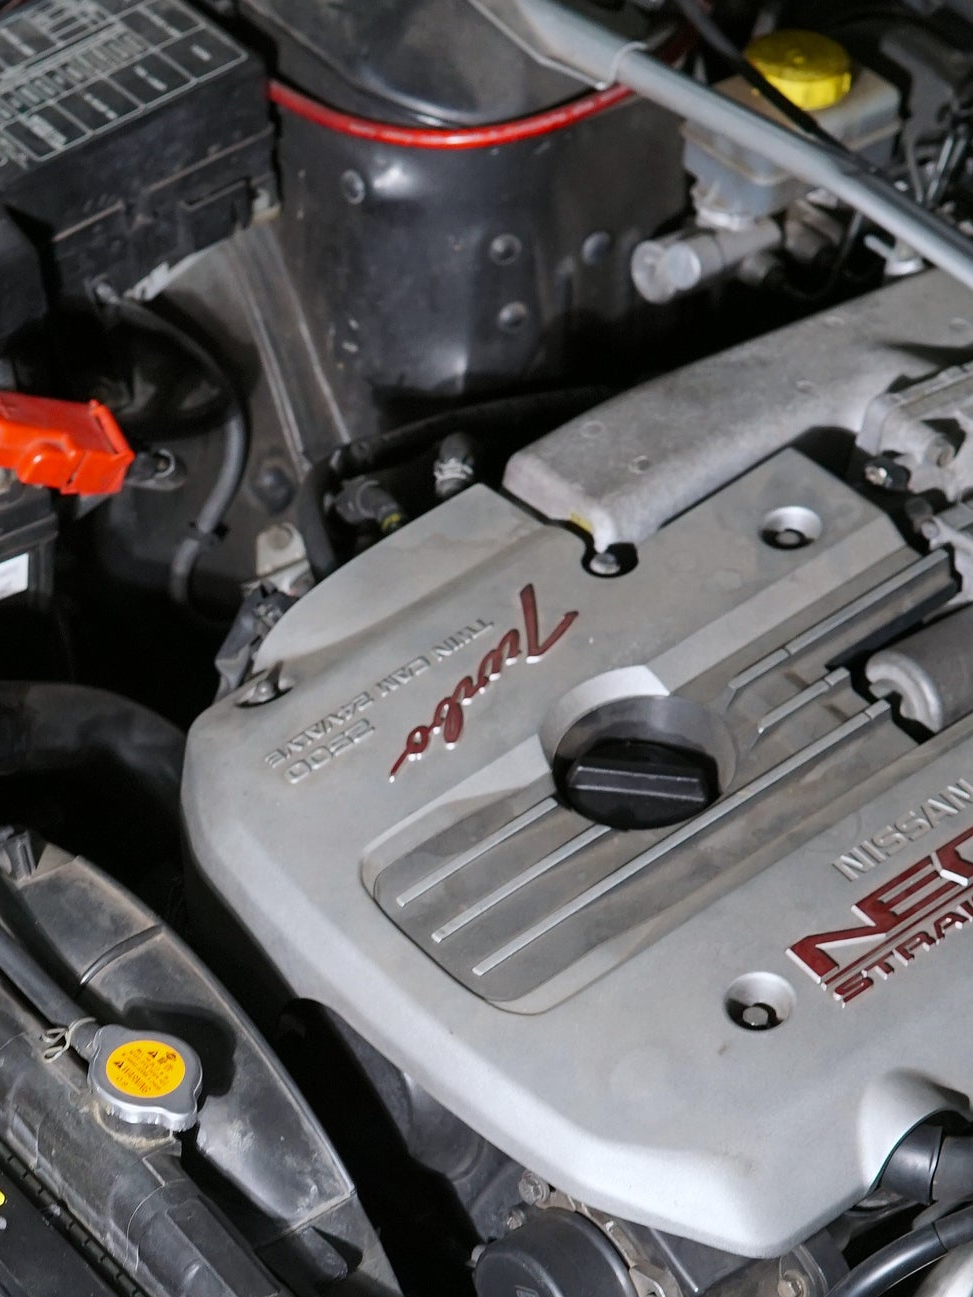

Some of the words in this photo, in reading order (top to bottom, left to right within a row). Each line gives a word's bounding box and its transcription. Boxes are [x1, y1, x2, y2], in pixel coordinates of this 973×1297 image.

[431, 618, 494, 662] TWIN
[375, 655, 431, 698] CAM
[390, 583, 579, 782] Turbo
[284, 718, 375, 784] 2500
[831, 778, 973, 882] NISSAN
